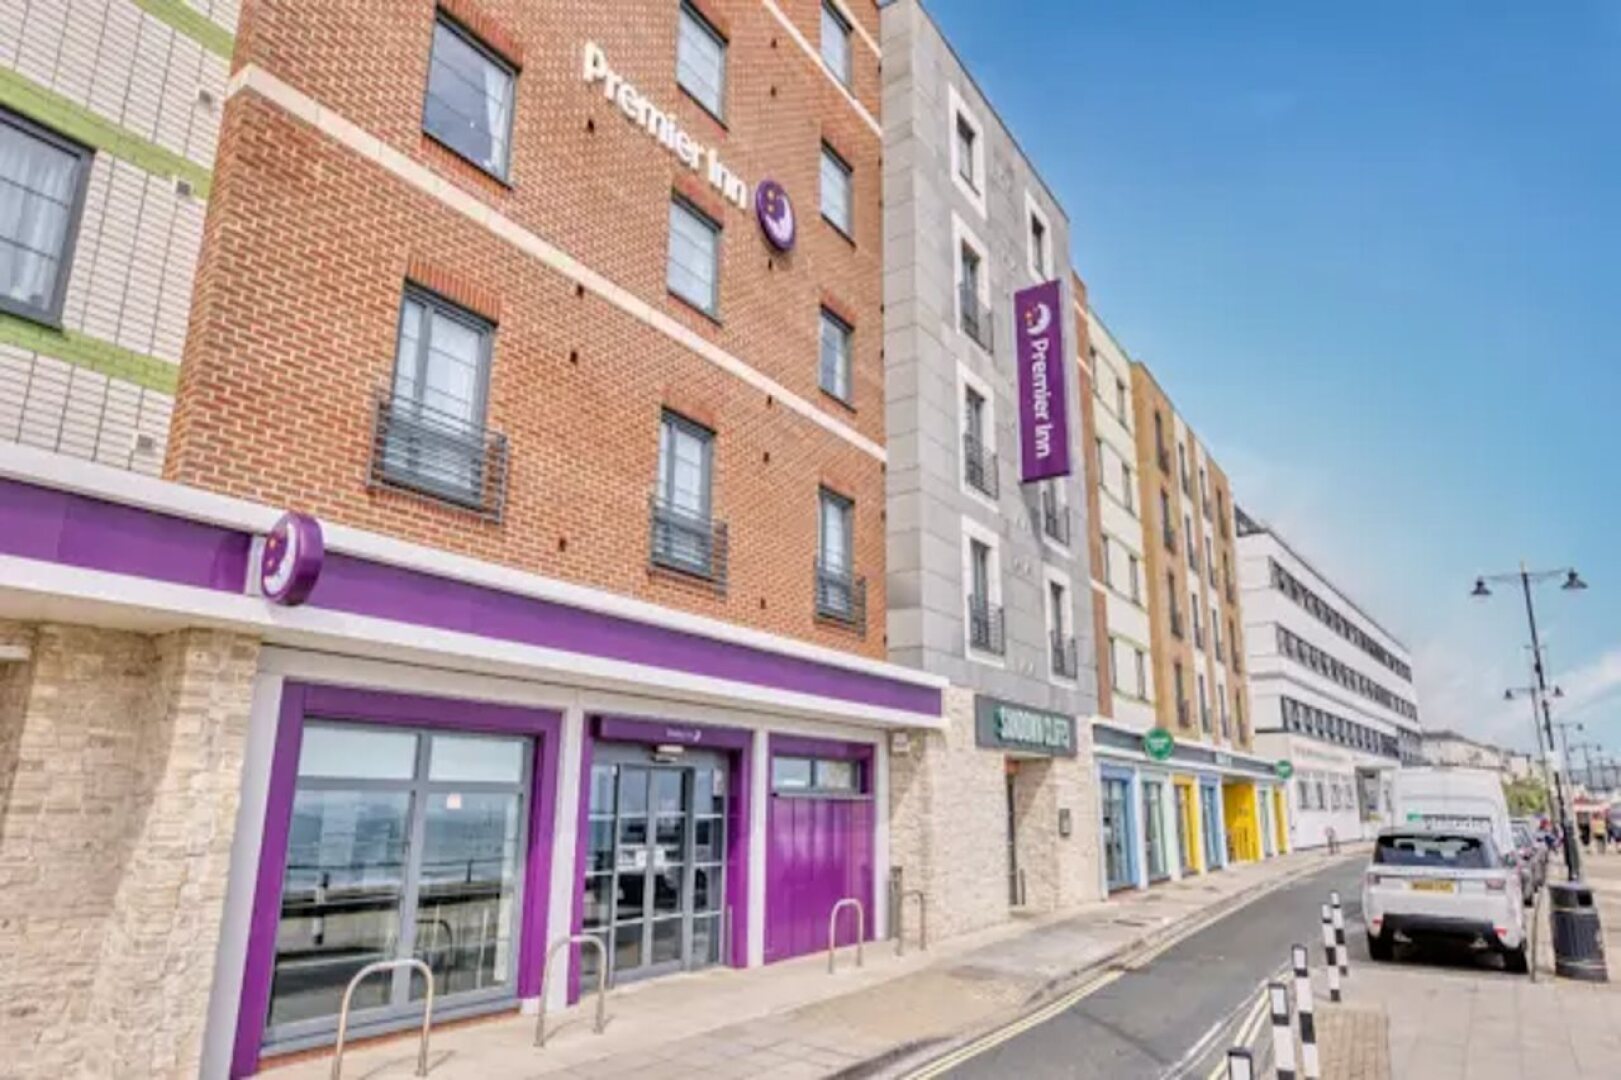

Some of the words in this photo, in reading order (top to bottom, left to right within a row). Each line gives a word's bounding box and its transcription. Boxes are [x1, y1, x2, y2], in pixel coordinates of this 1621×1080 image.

[583, 40, 704, 169] Premier
[707, 149, 747, 210] Inn
[1030, 337, 1051, 421] Premier
[1034, 424, 1053, 459] Inn
